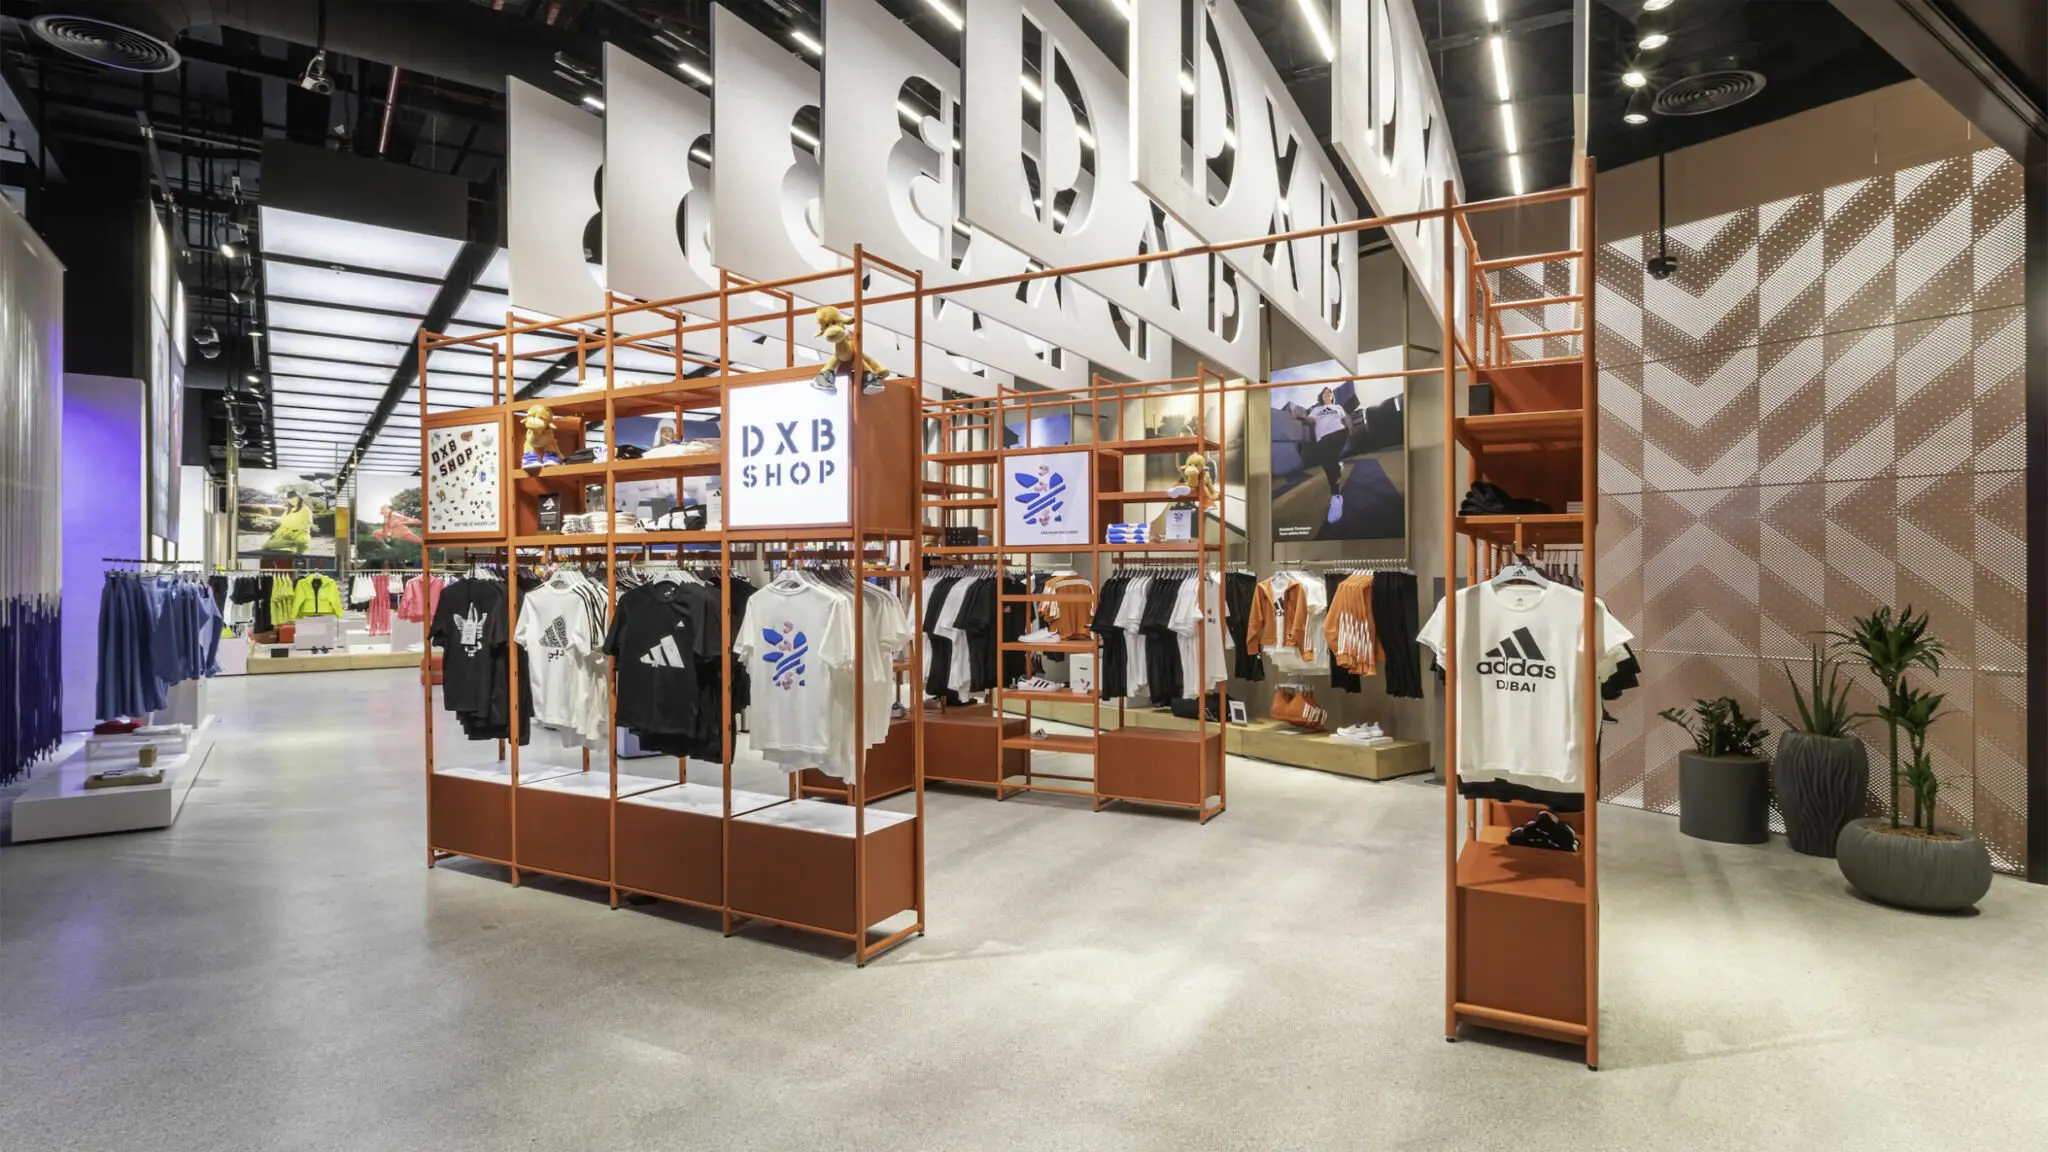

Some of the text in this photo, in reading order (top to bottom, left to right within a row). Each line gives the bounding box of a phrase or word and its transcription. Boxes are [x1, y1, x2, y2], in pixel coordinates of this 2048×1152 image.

[431, 440, 457, 464] DXB
[742, 418, 836, 458] DXB
[439, 447, 473, 477] SHOP
[742, 459, 835, 488] SHOP
[1476, 657, 1556, 680] adidas
